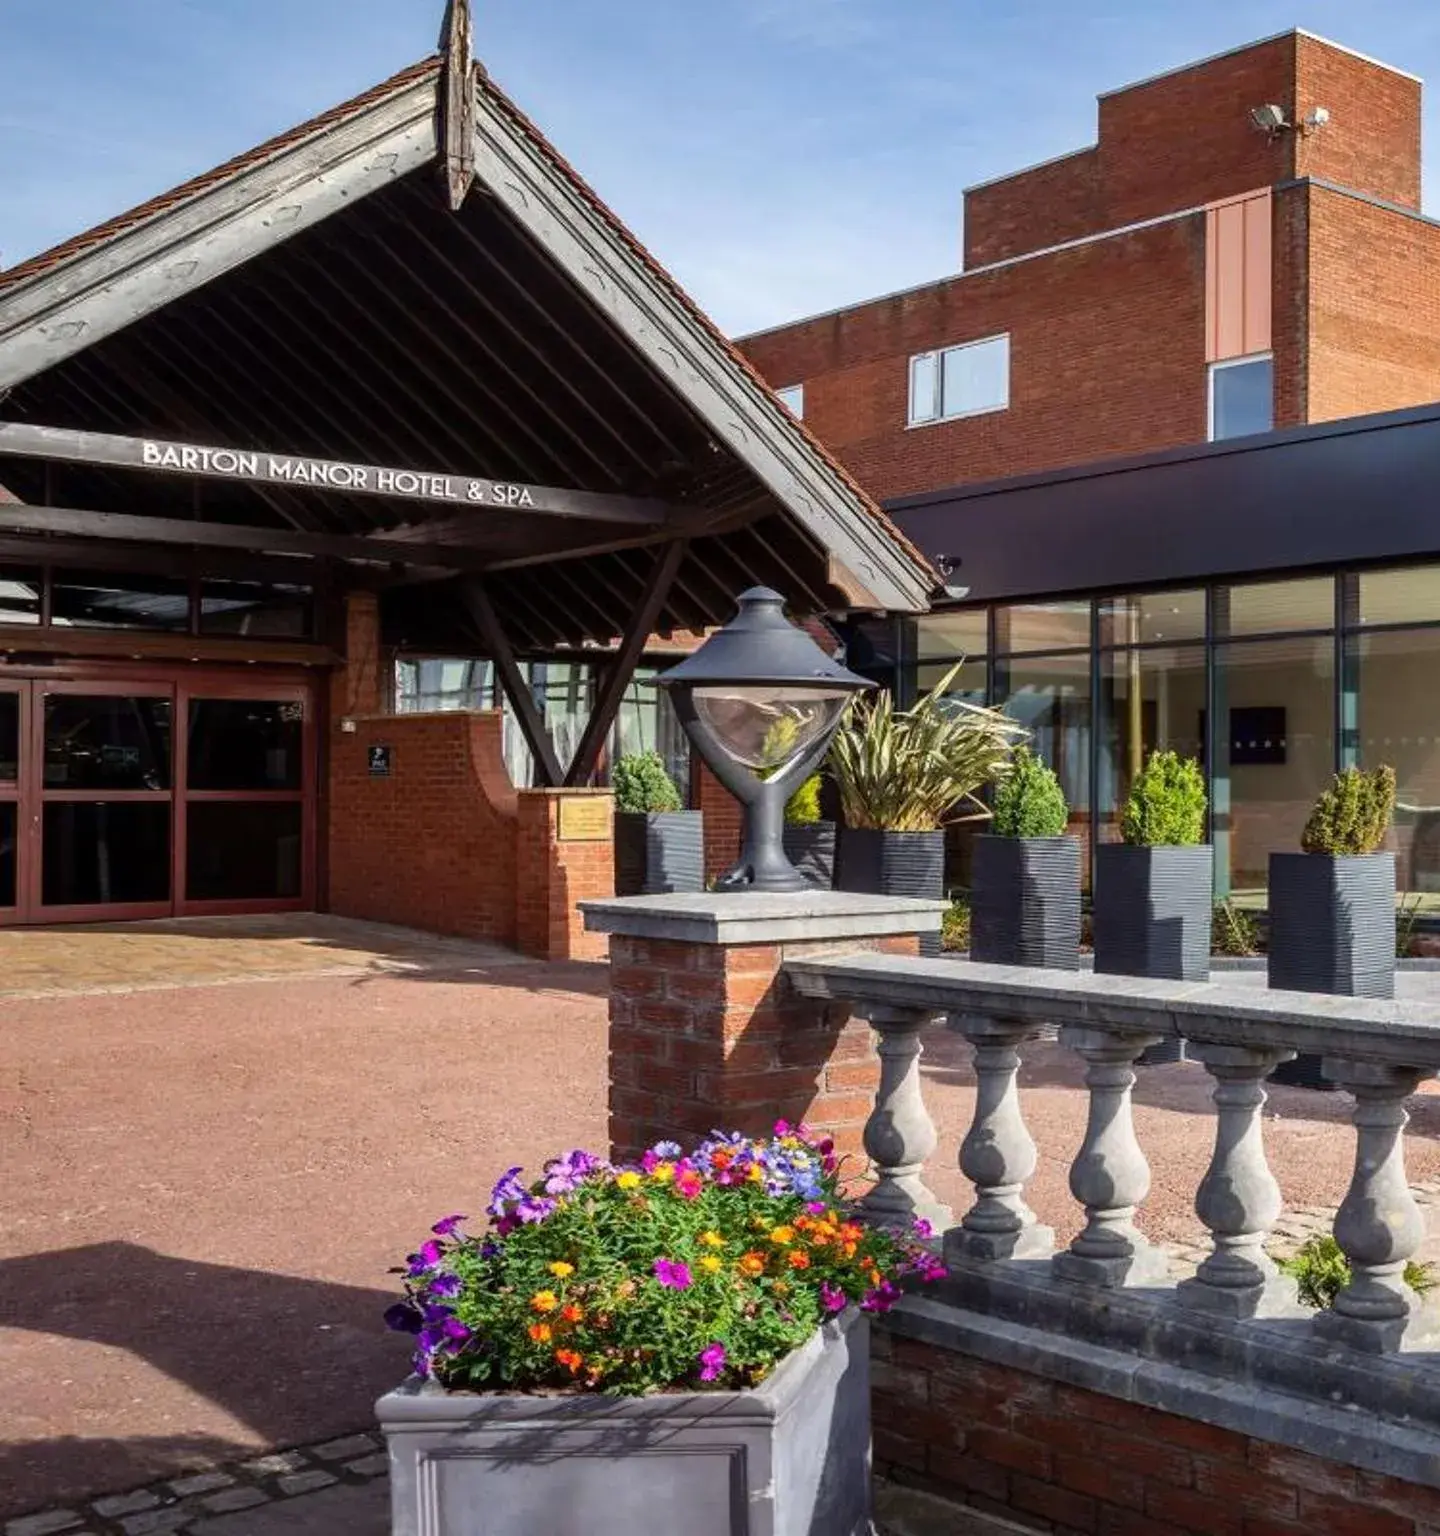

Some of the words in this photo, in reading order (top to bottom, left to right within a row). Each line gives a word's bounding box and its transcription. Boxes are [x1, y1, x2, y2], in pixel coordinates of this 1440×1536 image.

[142, 440, 258, 477] BARTON
[268, 455, 369, 489] MANOR
[376, 468, 458, 498] HOTEL
[467, 480, 484, 501] &
[492, 484, 534, 507] SPA
